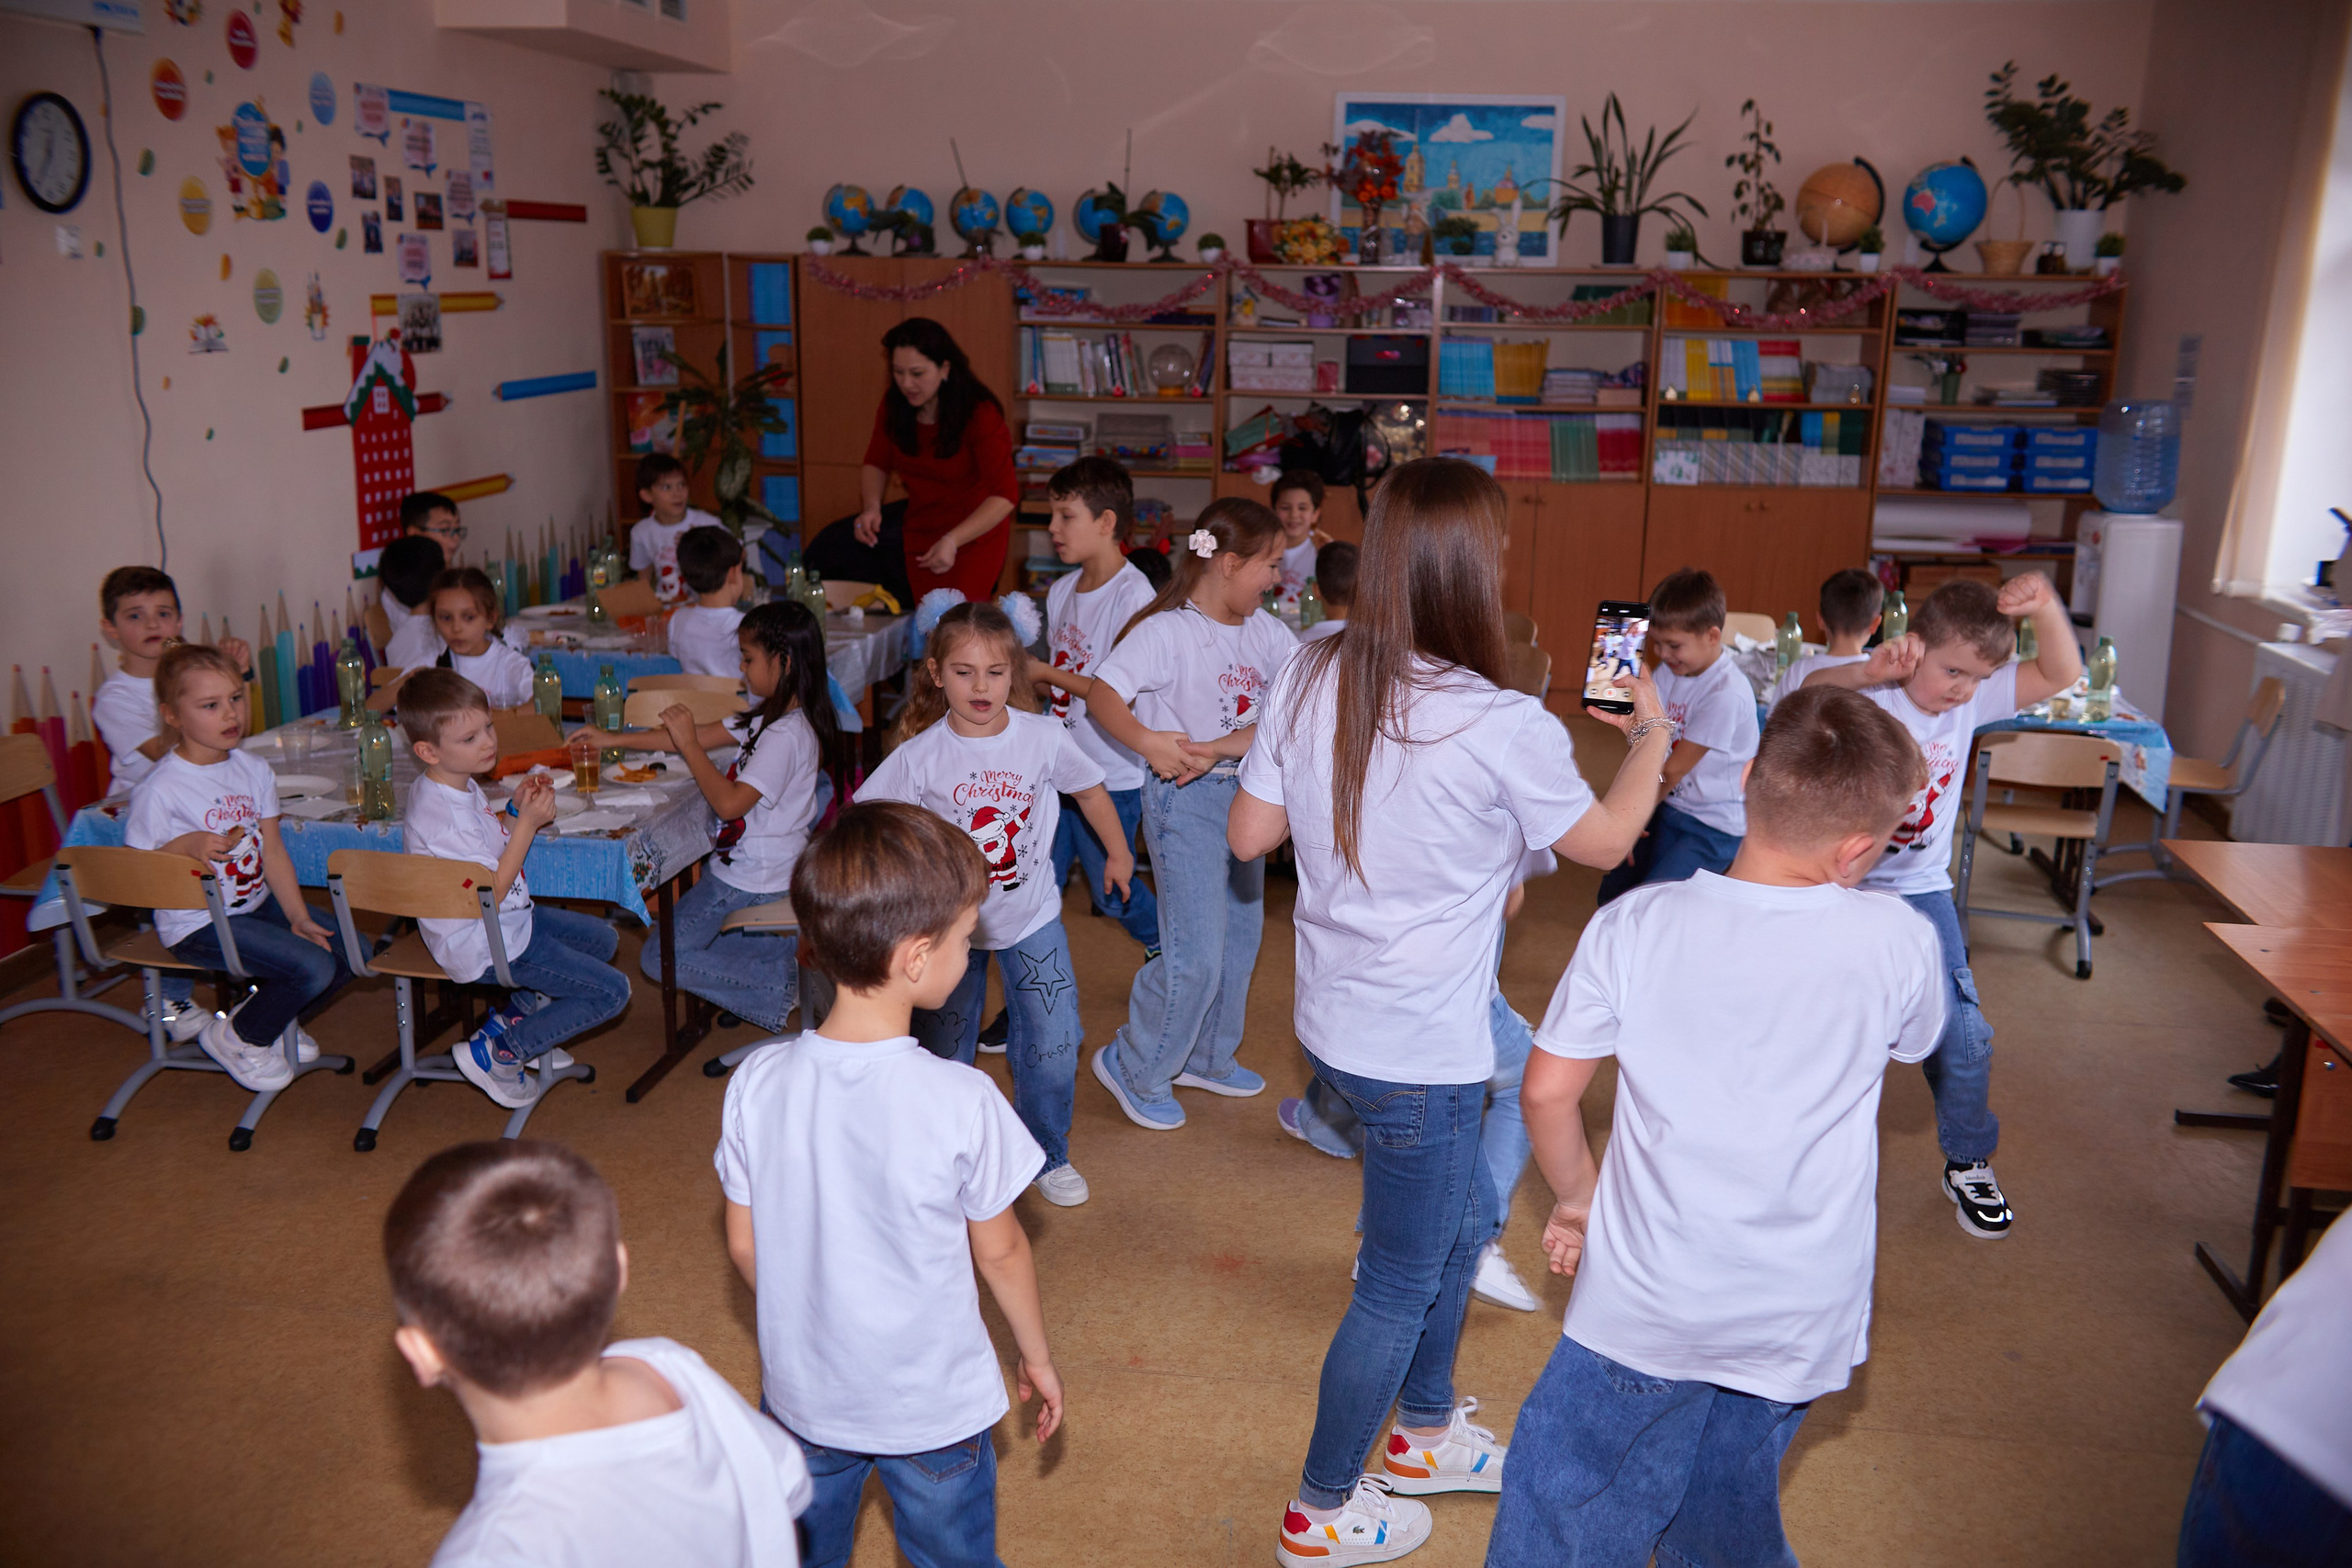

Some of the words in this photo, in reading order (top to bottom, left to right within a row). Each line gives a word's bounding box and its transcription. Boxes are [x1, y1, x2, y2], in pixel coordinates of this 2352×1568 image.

[980, 770, 1023, 786] Merry
[953, 781, 1035, 808] Christmas
[1024, 1031, 1072, 1068] Crush
